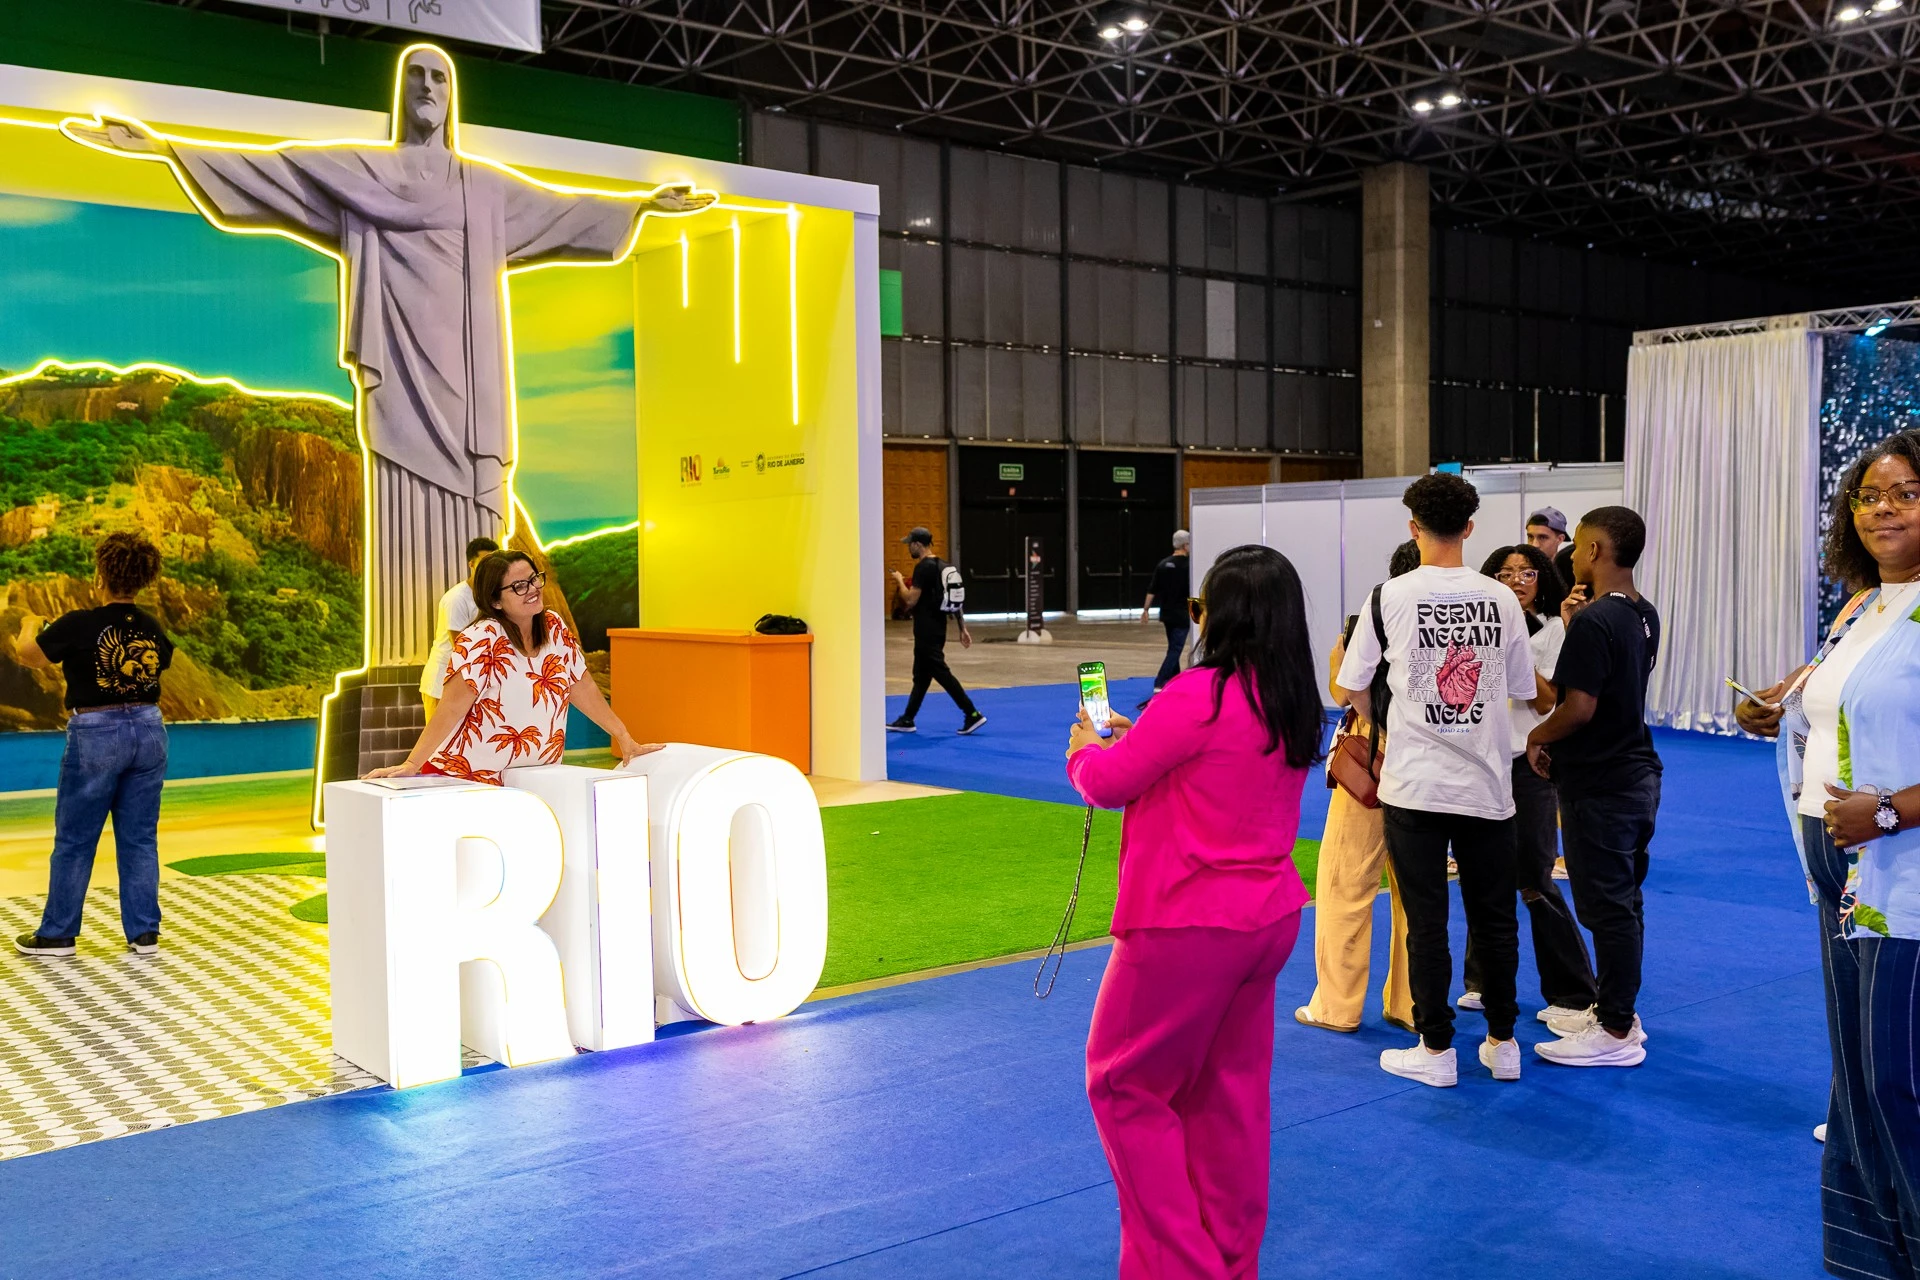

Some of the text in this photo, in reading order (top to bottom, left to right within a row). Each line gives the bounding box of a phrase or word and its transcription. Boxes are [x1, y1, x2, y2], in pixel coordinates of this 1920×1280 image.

[680, 454, 702, 482] RIO
[784, 458, 805, 466] JANEIRO
[1417, 601, 1502, 625] PERMA
[1418, 626, 1502, 648] NECAM
[1425, 703, 1484, 725] NELE
[386, 752, 828, 1090] RIO
